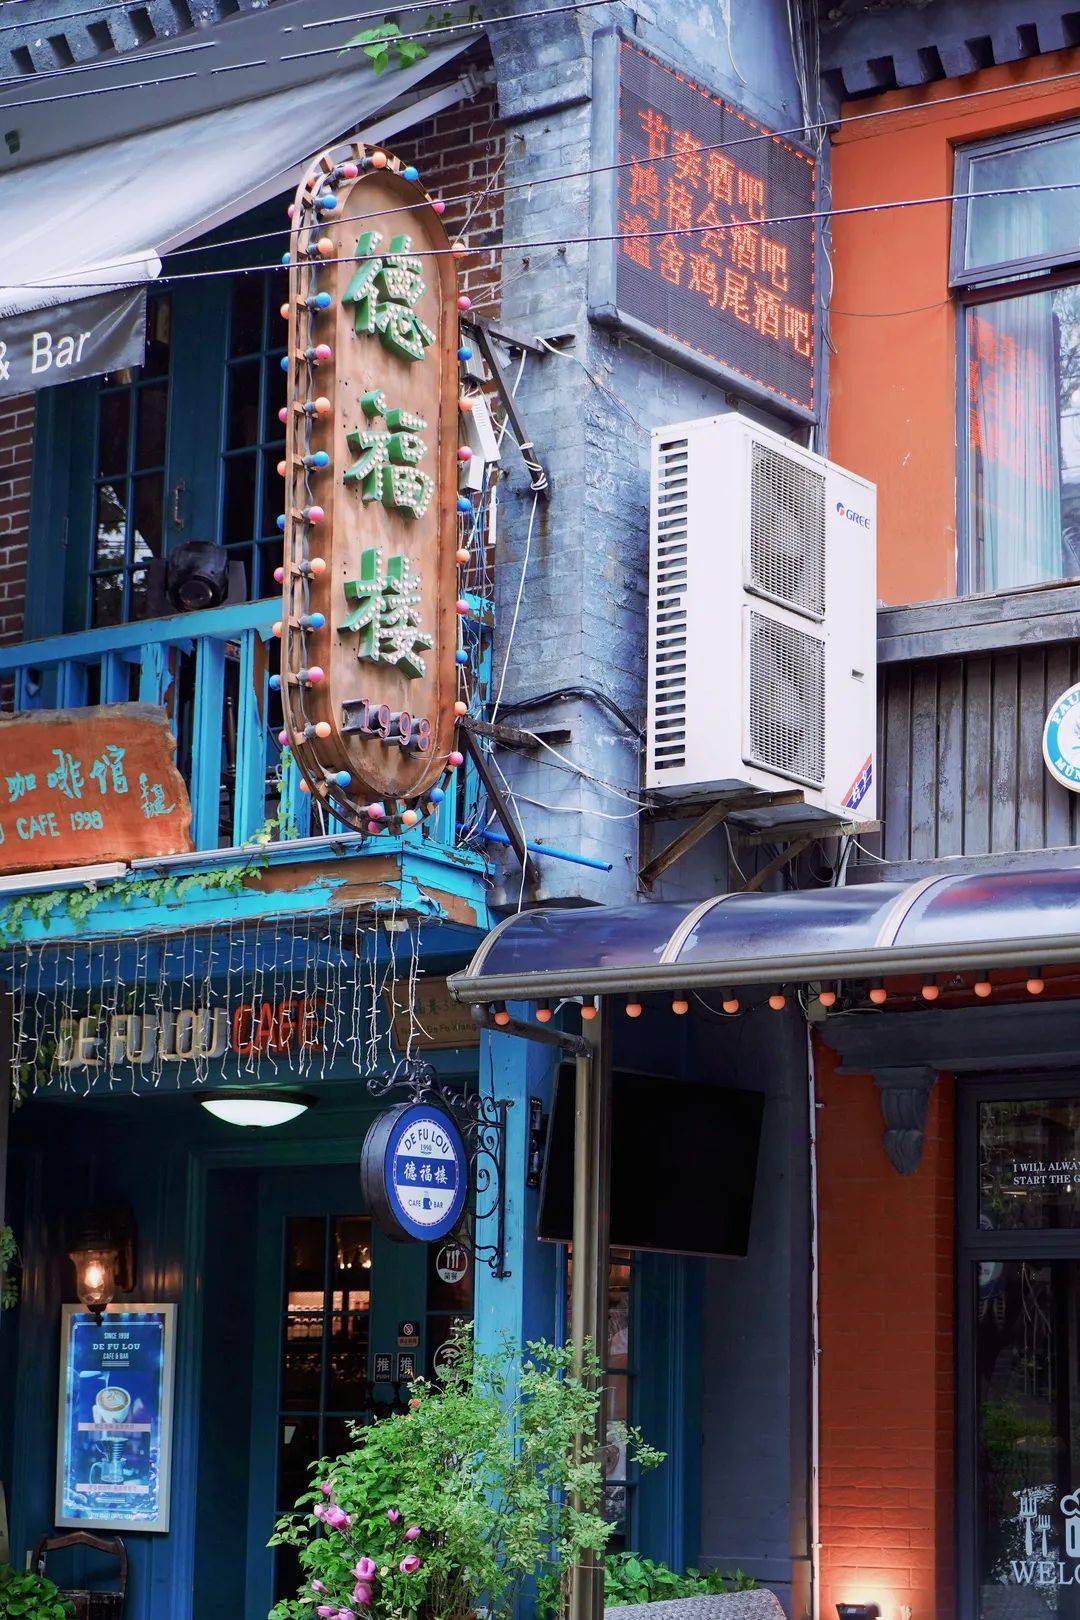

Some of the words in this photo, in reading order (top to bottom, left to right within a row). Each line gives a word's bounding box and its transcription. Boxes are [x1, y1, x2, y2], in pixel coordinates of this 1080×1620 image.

[638, 108, 766, 223] 节奏酒吧
[31, 331, 91, 374] Bar
[336, 230, 437, 680] 德福楼
[846, 509, 871, 530] GREE
[358, 698, 431, 752] 1998
[16, 812, 60, 840] CAFE
[70, 810, 104, 831] 1998
[233, 999, 327, 1055] CAFE
[404, 1132, 416, 1151] DE
[418, 1128, 429, 1141] FU
[431, 1132, 450, 1154] LOU
[403, 1160, 449, 1185] 德福楼
[1013, 1163, 1018, 1173] I
[1020, 1162, 1046, 1172] WILL
[1013, 1175, 1047, 1186] START
[1048, 1174, 1071, 1184] THE
[408, 1199, 421, 1207] CAFE
[433, 1200, 444, 1209] BAR
[104, 1332, 117, 1340] SINCE
[102, 1352, 115, 1360] CAFE
[120, 1352, 129, 1360] BAR
[376, 1357, 390, 1373] 推
[400, 1356, 413, 1372] 推
[1010, 1560, 1080, 1586] WEL
